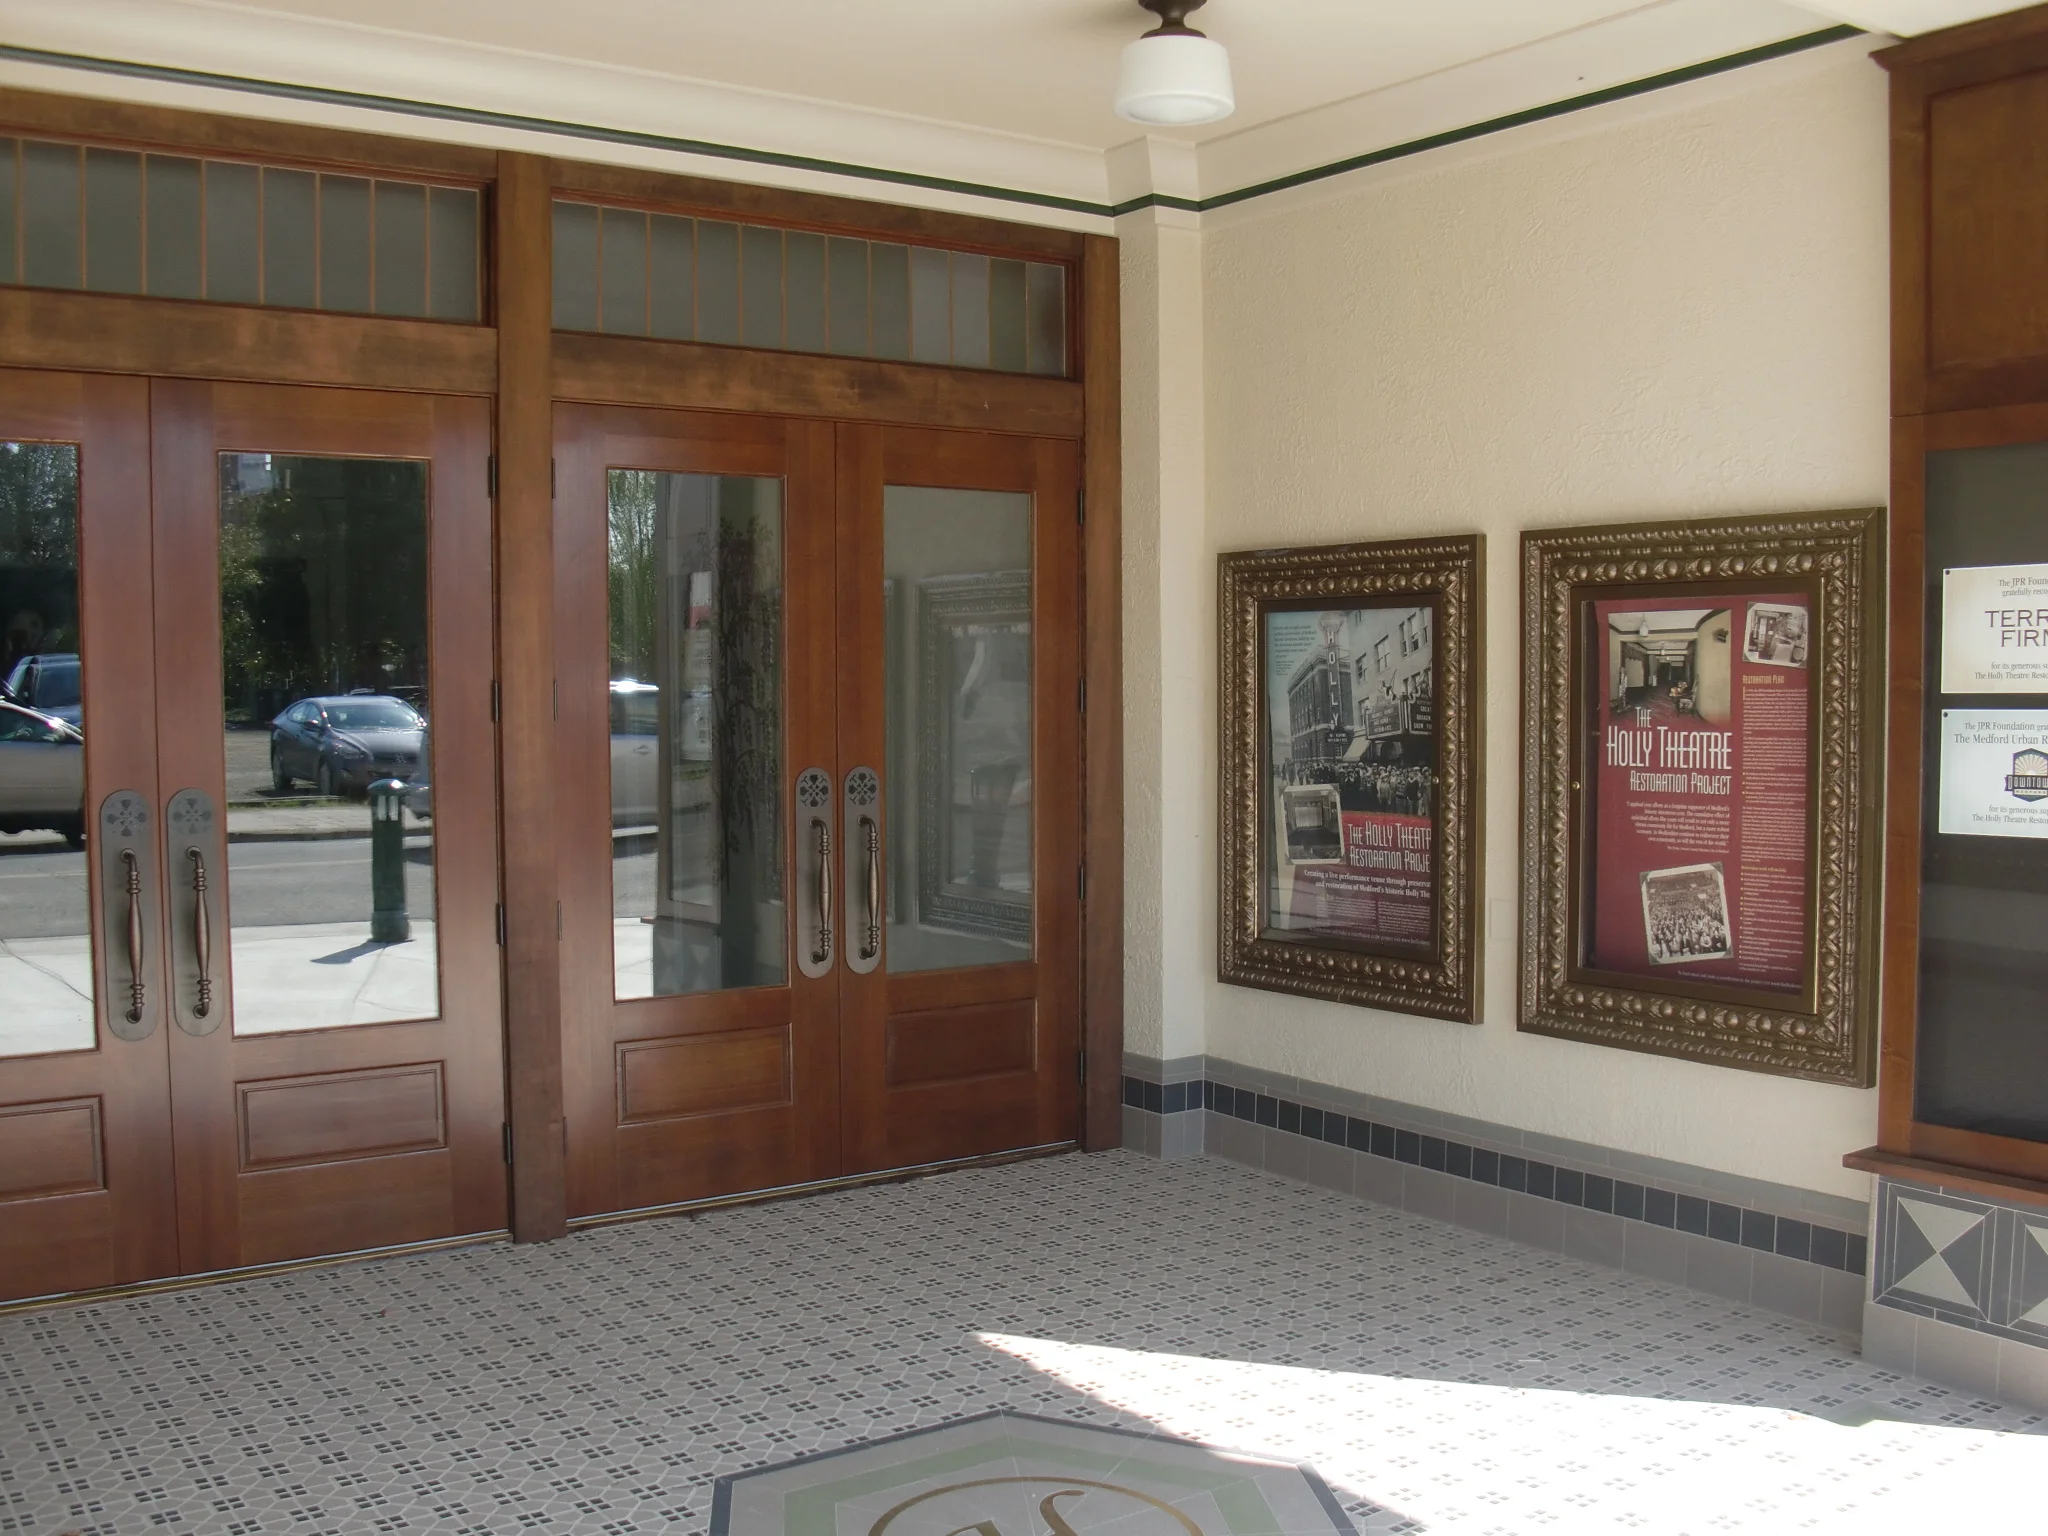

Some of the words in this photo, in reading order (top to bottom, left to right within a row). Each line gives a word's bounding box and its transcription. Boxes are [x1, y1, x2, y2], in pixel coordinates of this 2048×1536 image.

[1999, 579, 2010, 587] The
[2011, 577, 2026, 588] JPR
[2002, 588, 2032, 598] gratefully
[1984, 609, 2048, 628] TERR
[2011, 663, 2041, 671] generous
[1988, 672, 2003, 681] Holly
[2005, 671, 2029, 679] Theatre
[1635, 706, 1652, 728] THE
[1965, 722, 1976, 730] The
[1978, 721, 1991, 732] JPR
[1993, 721, 2034, 731] Foundation
[1954, 734, 1970, 744] The
[1973, 734, 2009, 744] Medford
[2012, 734, 2038, 745] Urban
[1606, 726, 1652, 767] HOLLY
[1657, 726, 1732, 770] THEATRE
[1630, 770, 1688, 793] RESTORATION
[1691, 772, 1732, 795] PROJECT
[1989, 804, 1999, 813] for
[2009, 807, 2038, 815] generous
[1972, 813, 1983, 821] The
[1986, 814, 2001, 823] Holly
[2003, 815, 2027, 823] Theatre
[1348, 824, 1363, 845] THE
[1365, 821, 1393, 847] HOLLY
[1350, 846, 1402, 870] RESTORATION
[1304, 870, 1324, 879] Creating
